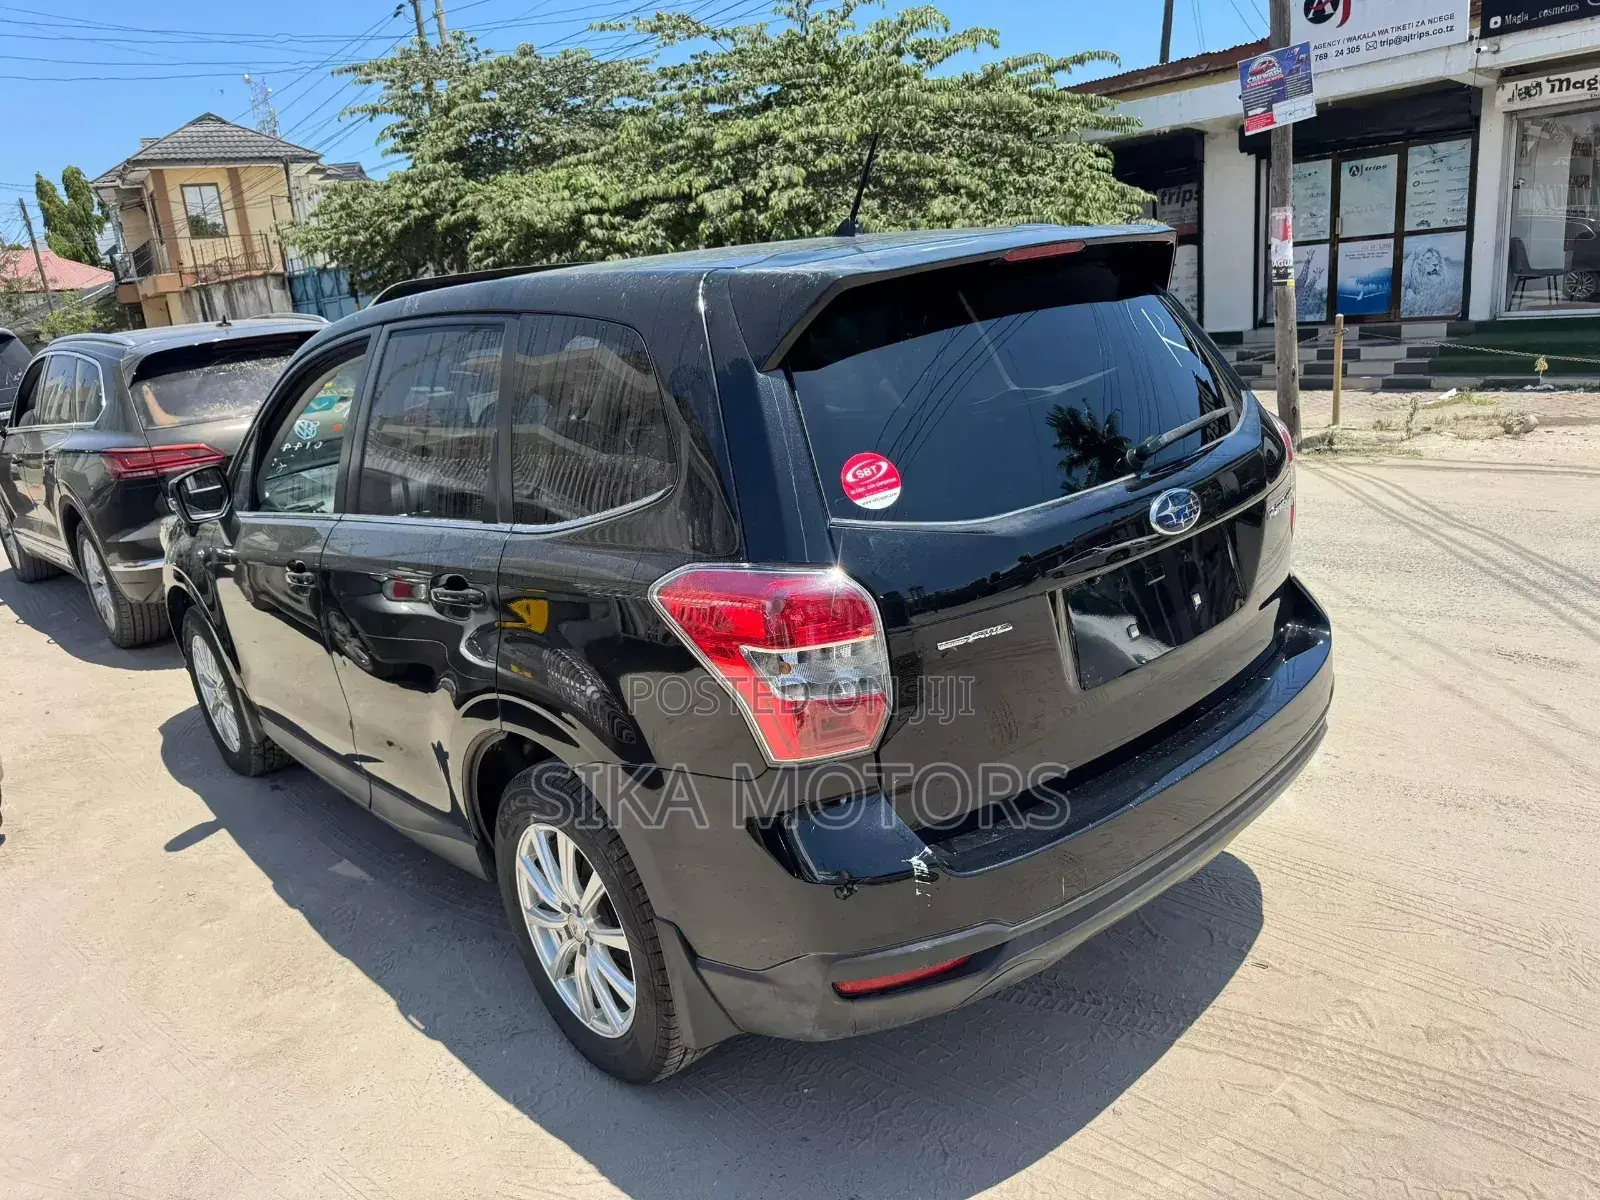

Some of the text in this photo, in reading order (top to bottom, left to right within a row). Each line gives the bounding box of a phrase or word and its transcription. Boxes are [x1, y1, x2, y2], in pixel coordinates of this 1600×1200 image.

[1313, 38, 1342, 51] AGENCY
[1346, 31, 1377, 43] WAKALA
[1377, 27, 1389, 36] WA
[1389, 22, 1414, 34] TIKETI
[1415, 19, 1426, 28] ZA
[1427, 12, 1455, 25] NDEGE
[1314, 52, 1328, 62] 769
[1345, 45, 1361, 55] 305
[1379, 24, 1455, 47] trip@ajtrips.co.tz
[1546, 74, 1600, 94] Mag
[1364, 163, 1388, 173] trips
[855, 464, 878, 479] SBT
